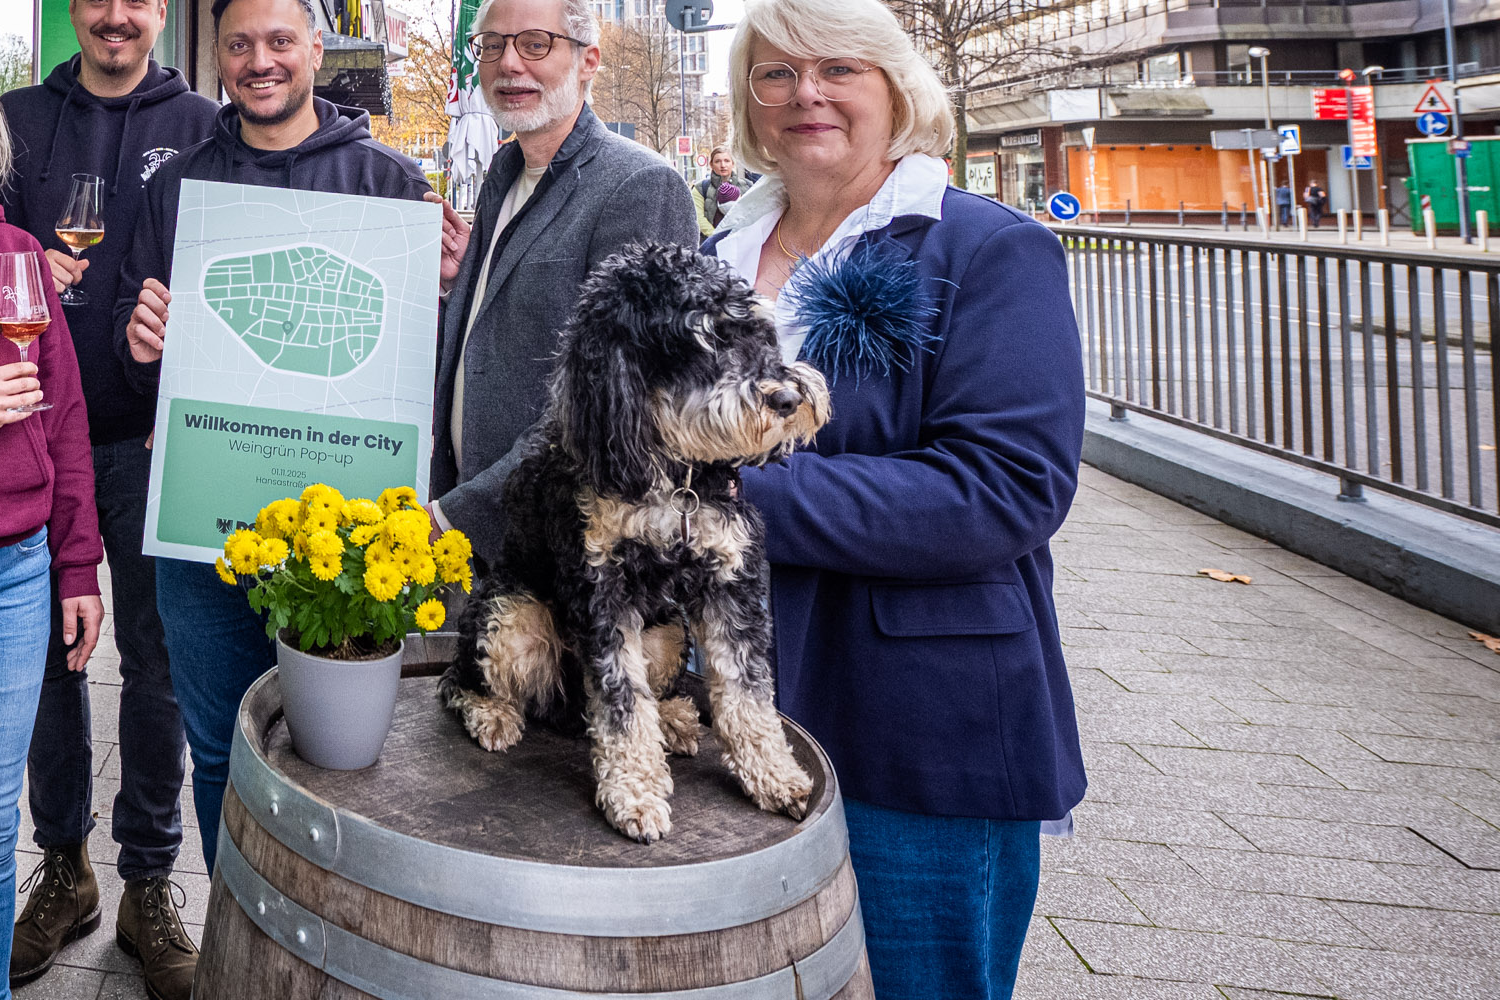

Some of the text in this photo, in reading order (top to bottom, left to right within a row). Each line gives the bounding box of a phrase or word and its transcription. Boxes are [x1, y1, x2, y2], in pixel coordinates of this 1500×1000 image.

[184, 413, 404, 456] Willkommen in der City
[228, 438, 354, 468] Weingrün Pop-up
[271, 467, 307, 479] 01.11.2025
